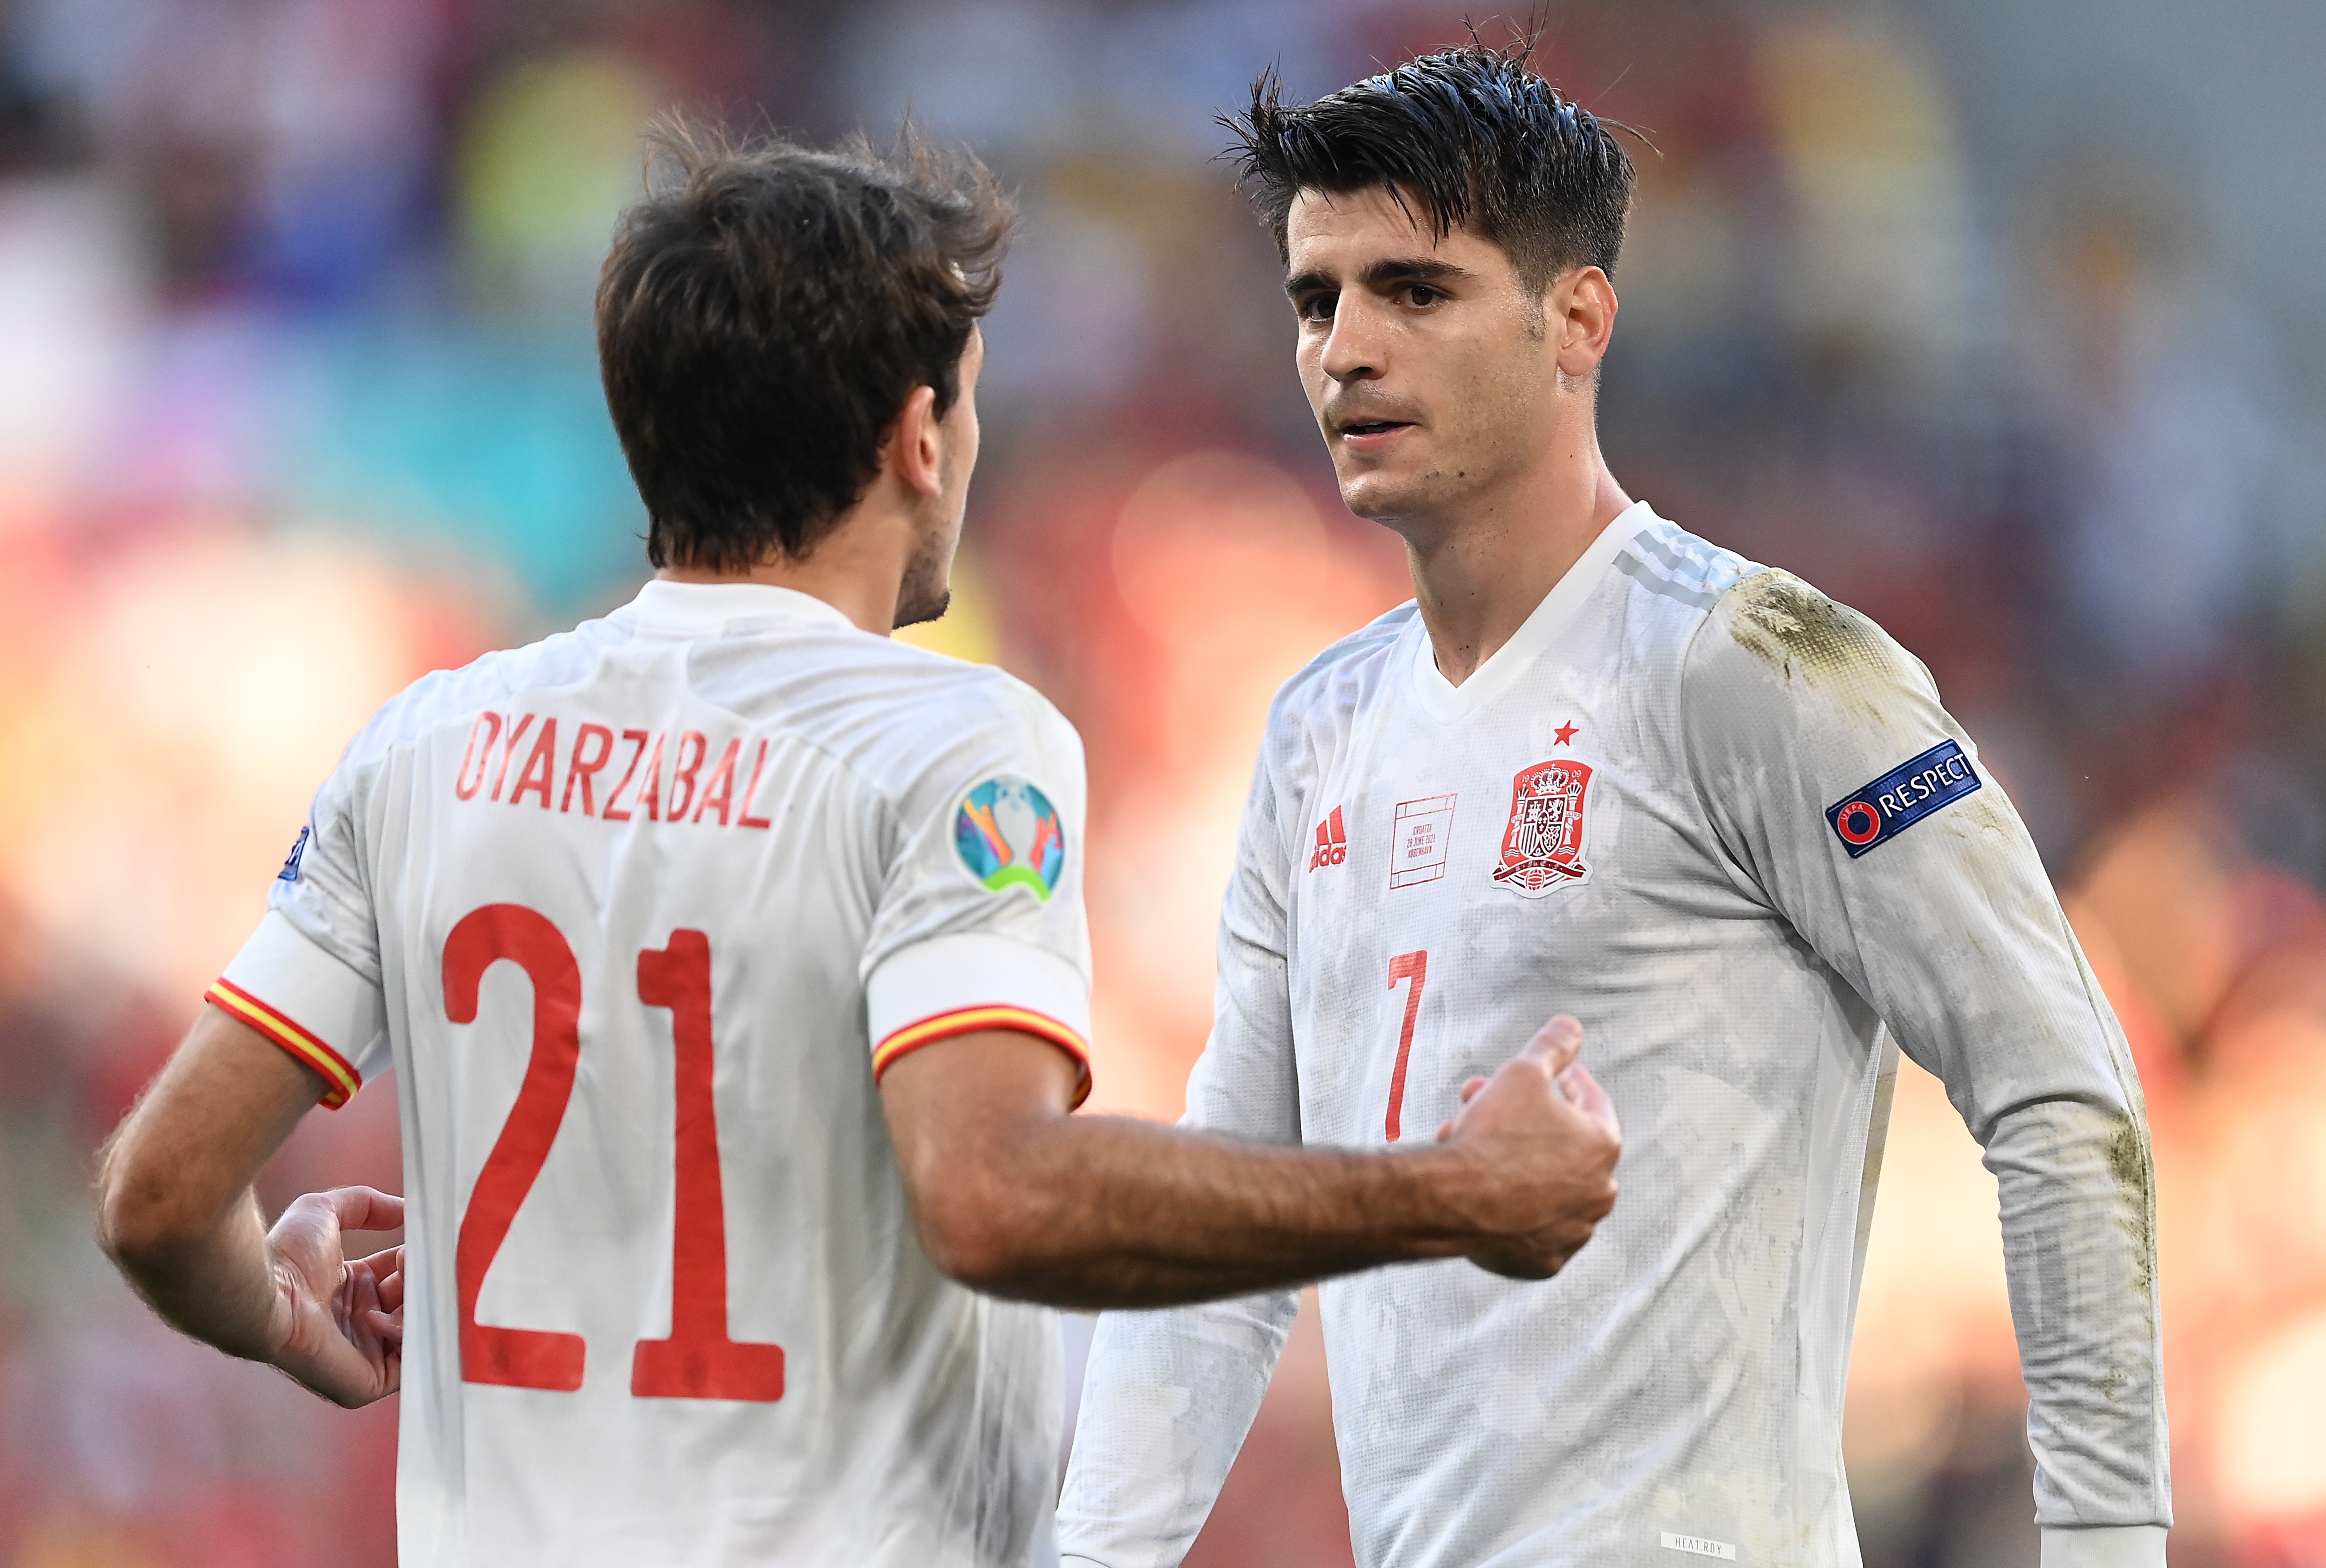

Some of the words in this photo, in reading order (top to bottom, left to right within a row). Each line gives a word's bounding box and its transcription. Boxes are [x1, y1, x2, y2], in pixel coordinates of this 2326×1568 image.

[455, 710, 772, 830] OYARZABAL
[1522, 774, 1530, 782] 19
[1571, 770, 1582, 778] 09
[1841, 803, 1864, 821] UEFA
[1878, 753, 1970, 818] RESPECT
[1385, 949, 1428, 1143] 7
[441, 902, 786, 1403] 21
